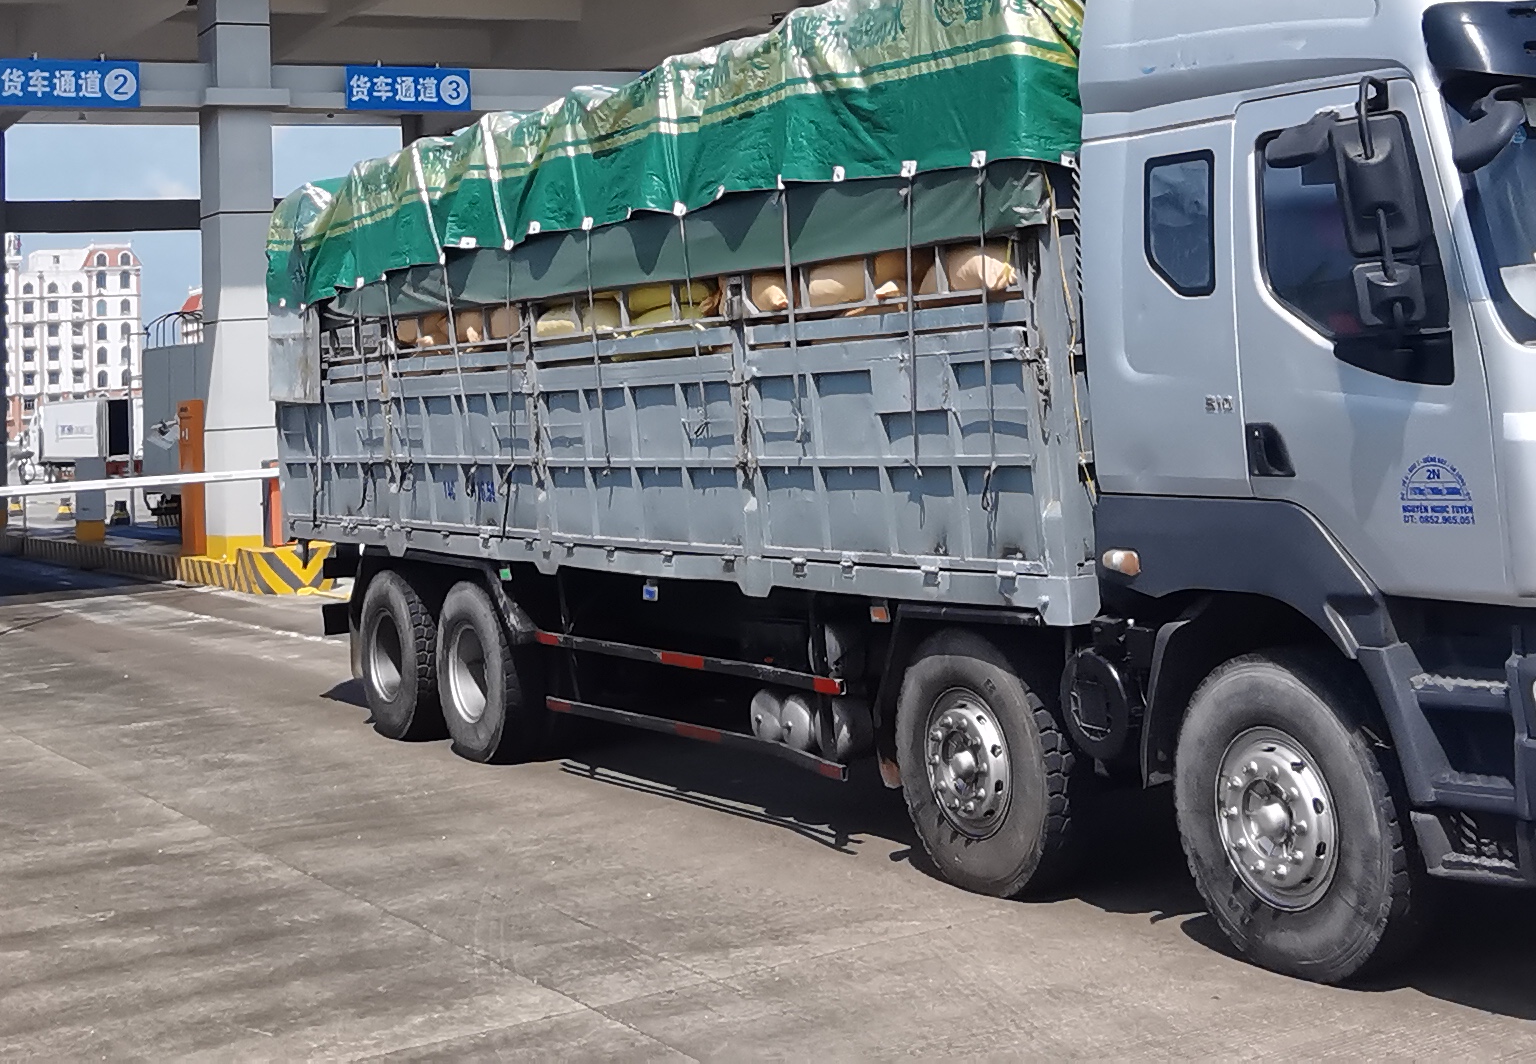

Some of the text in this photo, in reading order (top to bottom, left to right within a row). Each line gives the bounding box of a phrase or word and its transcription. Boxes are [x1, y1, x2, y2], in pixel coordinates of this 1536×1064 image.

[1, 67, 102, 98] 货车通道
[349, 74, 439, 103] 货车通道
